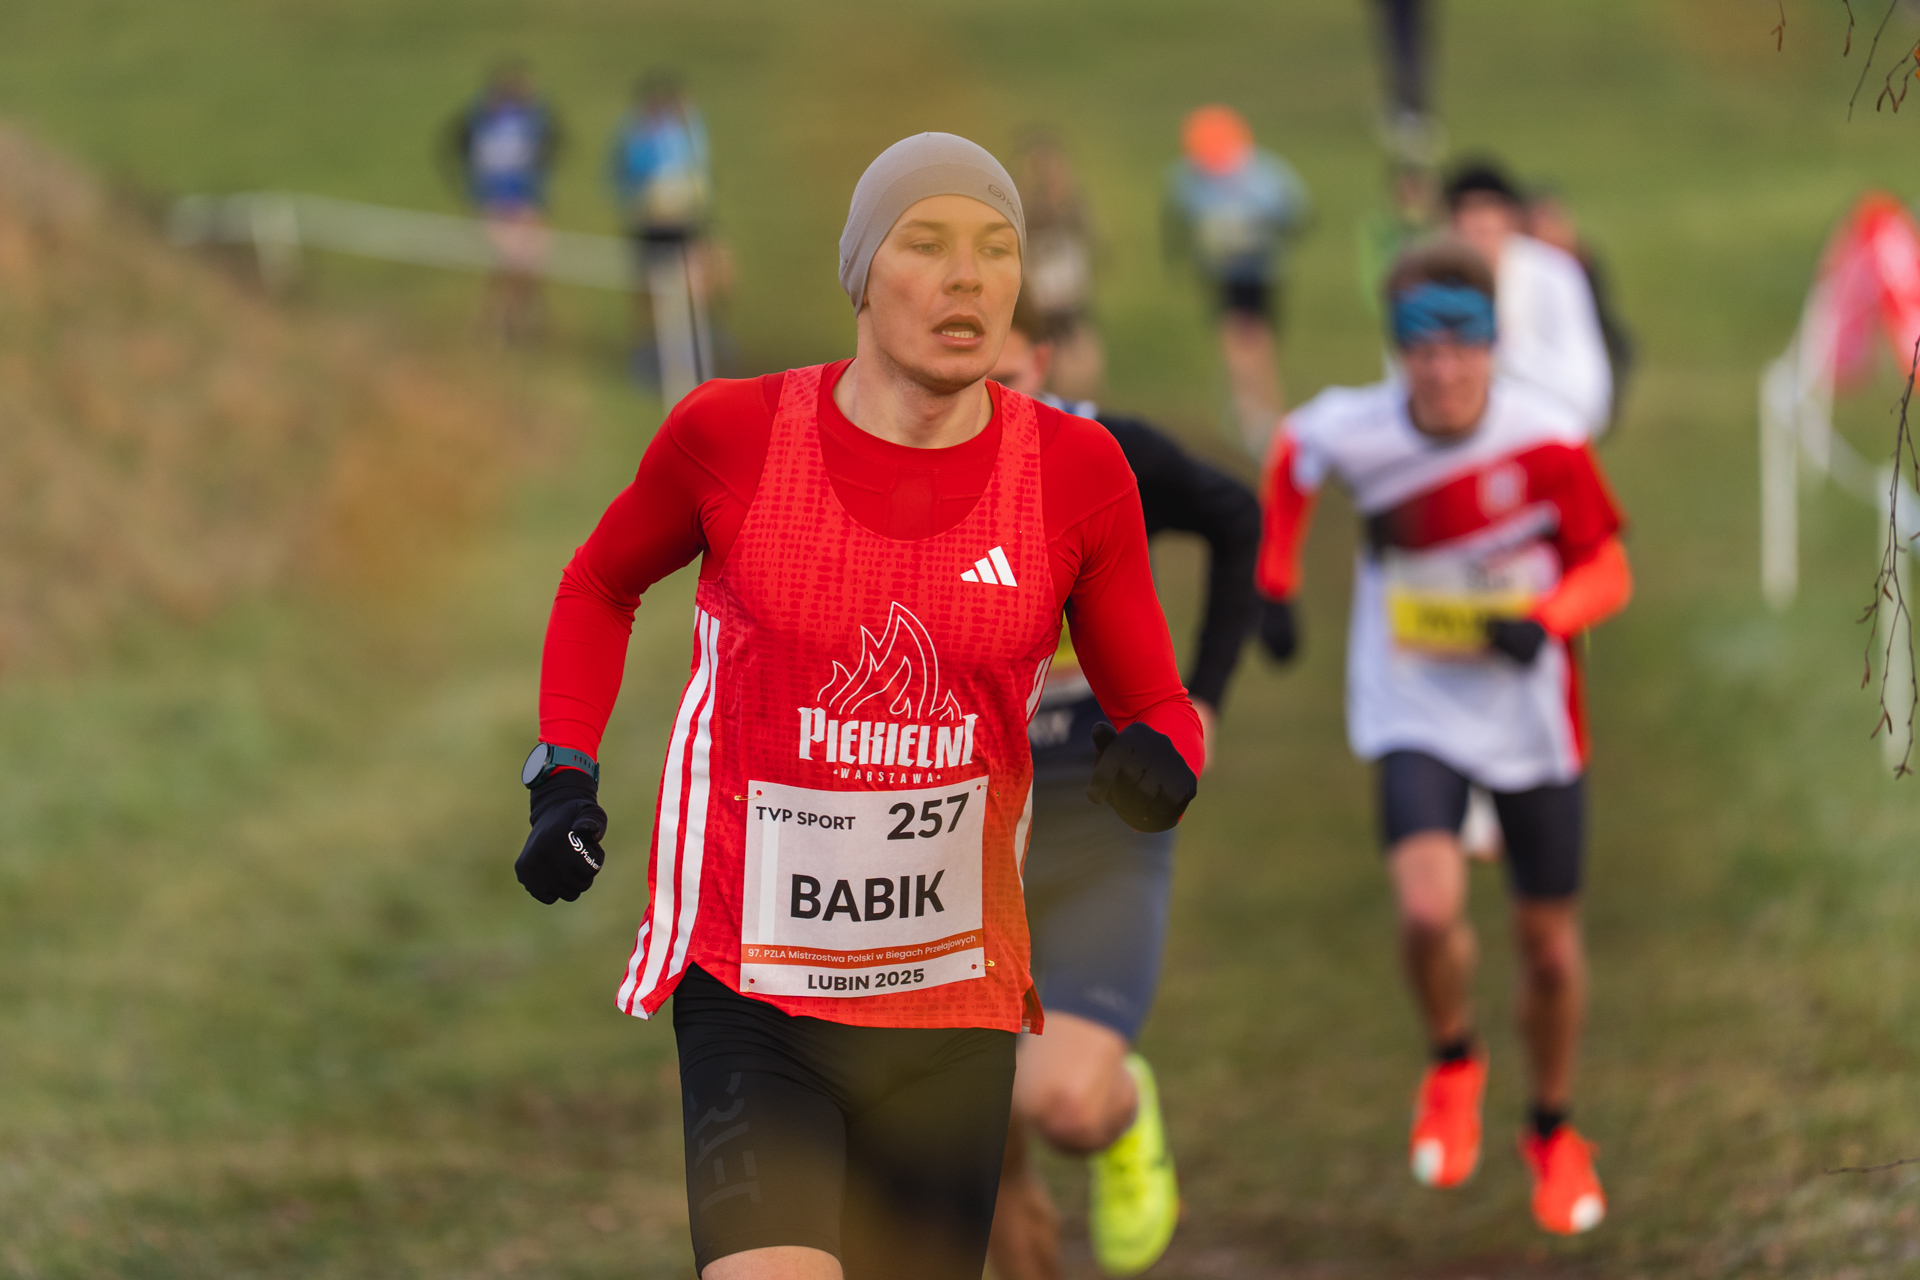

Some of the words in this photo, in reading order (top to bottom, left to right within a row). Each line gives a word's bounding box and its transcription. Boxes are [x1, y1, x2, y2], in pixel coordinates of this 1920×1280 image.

[840, 767, 934, 784] WARSZAWA
[755, 806, 793, 823] TVP
[797, 811, 856, 830] SPORT
[887, 791, 970, 841] 257
[790, 869, 946, 923] BABIK
[748, 948, 762, 958] 97.
[764, 949, 786, 959] PZLA
[788, 950, 845, 963] Mistrzostwa
[847, 953, 874, 963] Polski
[885, 949, 923, 960] Biegach
[807, 974, 870, 991] LUBIN
[875, 968, 925, 988] 2025
